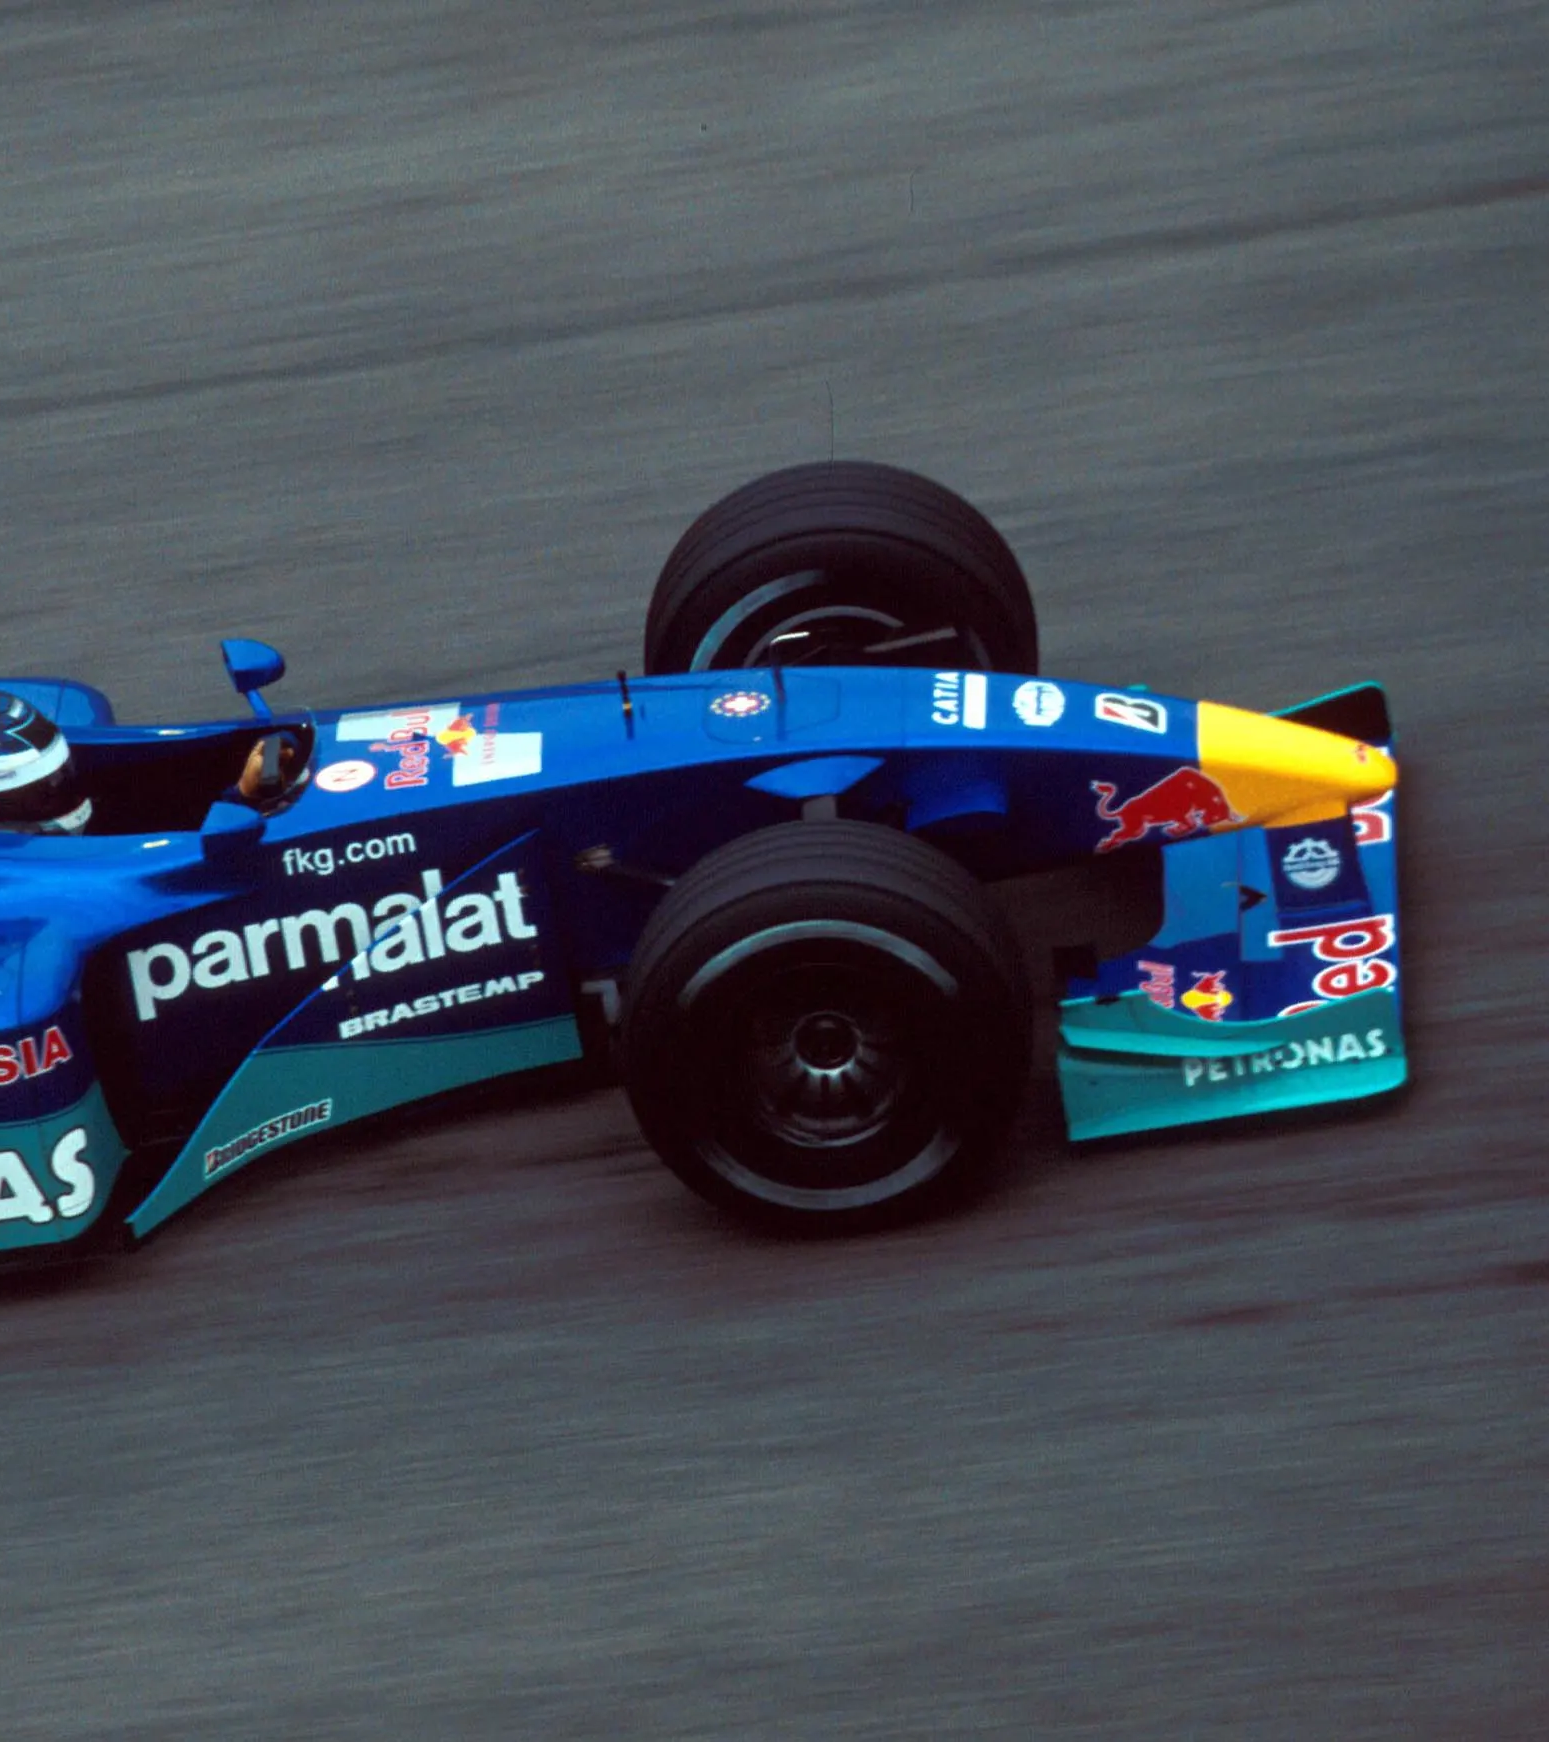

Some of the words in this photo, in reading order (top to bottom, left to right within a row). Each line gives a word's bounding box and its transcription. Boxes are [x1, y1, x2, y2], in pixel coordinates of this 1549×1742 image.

[281, 831, 417, 876] fkg.com
[126, 868, 538, 1021] parmalat
[1267, 913, 1398, 1018] ed
[339, 970, 545, 1039] BRASTEMP
